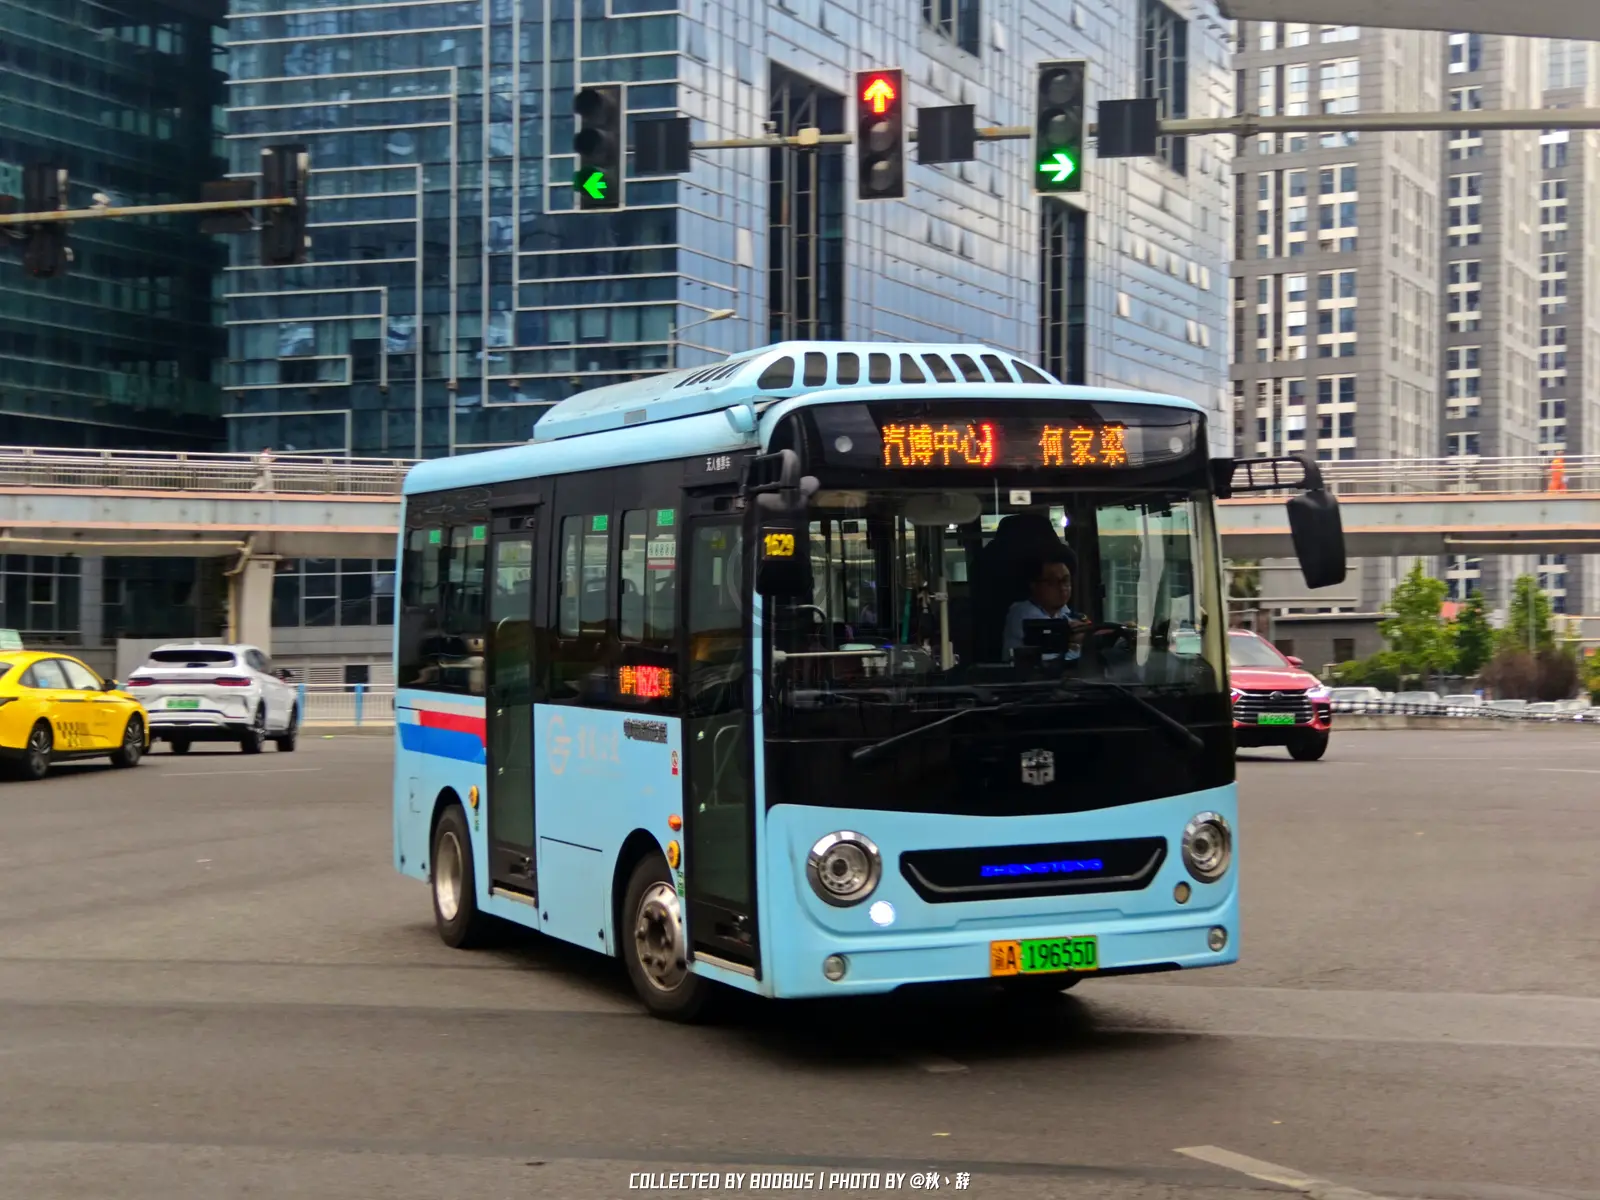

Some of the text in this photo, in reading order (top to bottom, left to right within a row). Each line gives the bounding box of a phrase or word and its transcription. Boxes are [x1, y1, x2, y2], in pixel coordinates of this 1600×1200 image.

[882, 423, 985, 467] 汽博中心
[1038, 424, 1127, 468] 何家梁
